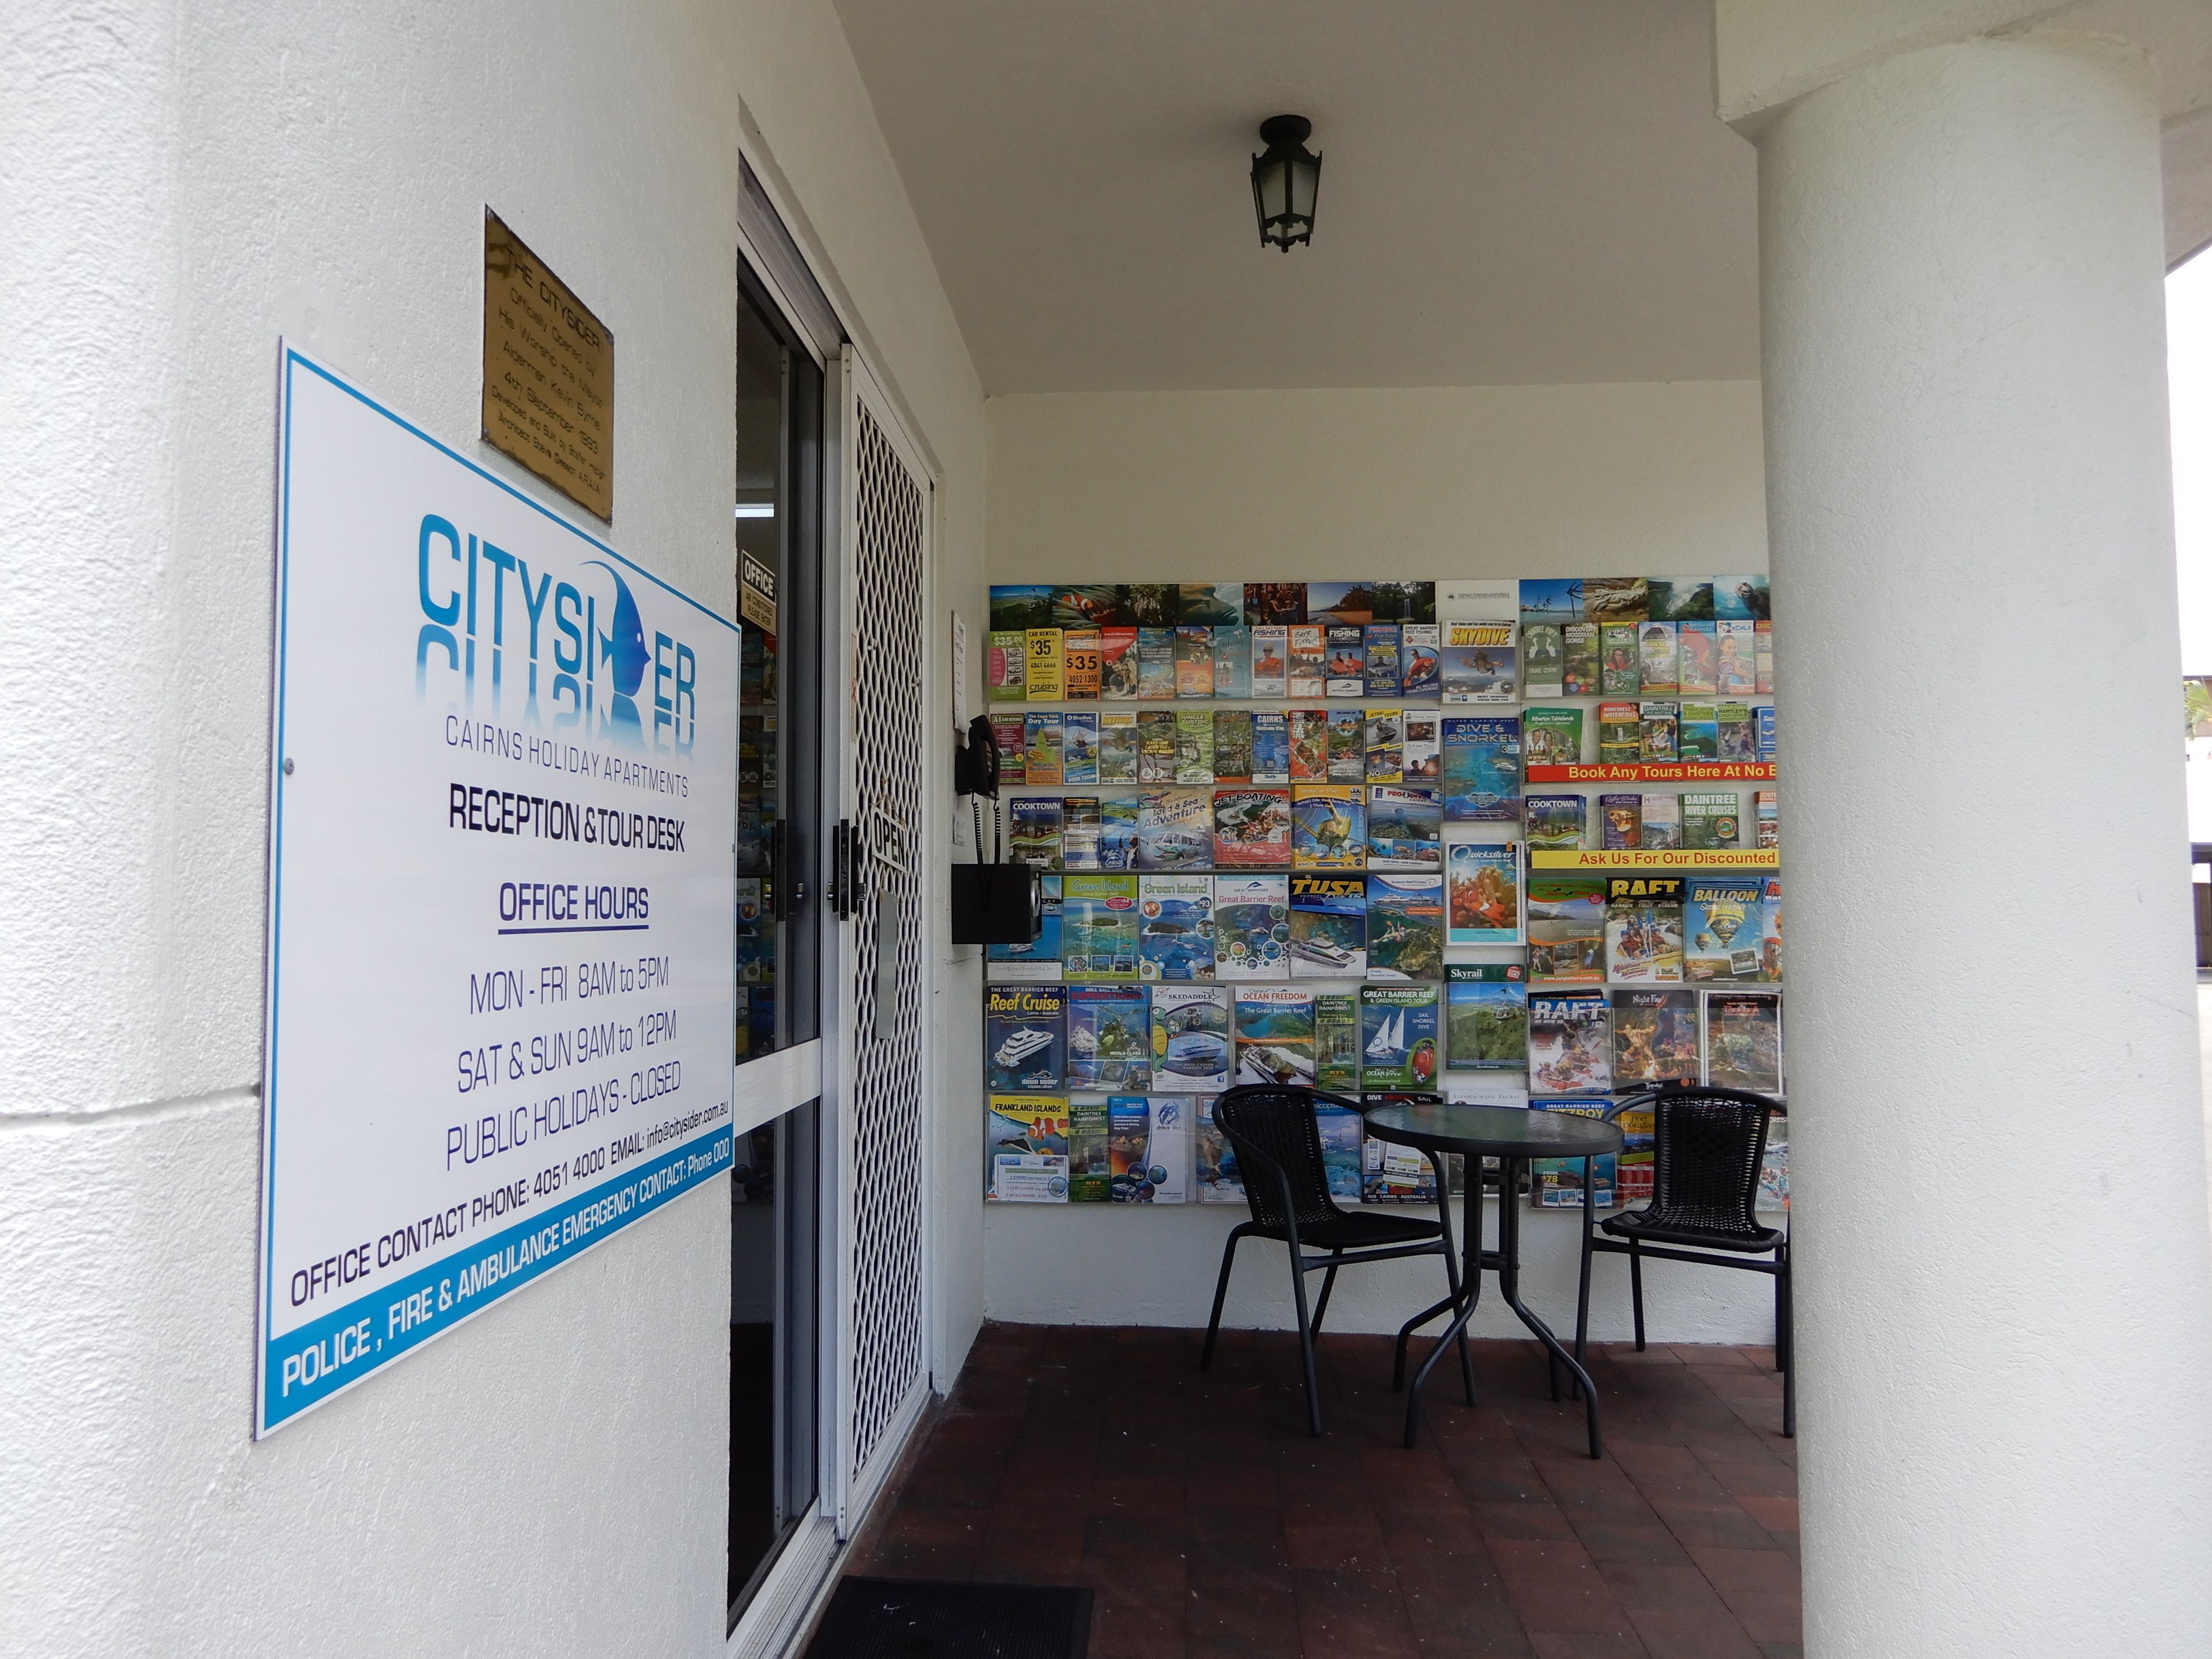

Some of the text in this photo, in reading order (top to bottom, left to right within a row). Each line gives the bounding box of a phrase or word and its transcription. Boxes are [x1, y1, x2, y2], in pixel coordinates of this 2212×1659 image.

[505, 245, 600, 351] THE CITYSIDER
[520, 324, 556, 367] Worship
[503, 340, 546, 385] Alderman
[551, 378, 573, 407] Kevin
[505, 372, 522, 392] 4th
[528, 387, 574, 433] September
[744, 559, 774, 598] OFFICE
[1329, 630, 1360, 638] FISHING
[1449, 628, 1512, 646] SKYDIVE
[1066, 656, 1098, 671] $35
[1029, 682, 1059, 694] cruising
[1069, 675, 1098, 684] 4052 1300
[1257, 715, 1284, 724] CAIRNS
[1456, 724, 1505, 733] DIVE &
[1447, 734, 1517, 743] SNORKEL
[446, 715, 689, 798] CAIRNS HOLIDAY APARTMENTS
[1569, 766, 1606, 778] Book
[1610, 766, 1638, 781] Any
[1642, 766, 1683, 777] Tours
[1687, 765, 1721, 777] Here
[1724, 765, 1742, 777] At
[1744, 765, 1764, 777] No
[1013, 802, 1060, 810] COOKTOWN
[1684, 794, 1737, 805] DAINTREE
[449, 782, 580, 842] RECEPTION
[647, 815, 685, 853] DESK
[1143, 804, 1206, 829] Adventure
[1684, 805, 1737, 815] RIVER CRUISES
[874, 811, 906, 868] OPEN
[1451, 845, 1515, 863] Quicksilver
[1579, 852, 1775, 865] Ask Us For Our Discounted
[1072, 879, 1129, 892] Green Island
[1145, 883, 1208, 894] Green Island
[1292, 879, 1365, 895] TUSA
[1611, 880, 1680, 897] RAFT
[499, 882, 649, 921] OFFICE HOURS
[1693, 889, 1759, 902] BALLOON
[1450, 968, 1483, 979] Skyrail
[470, 969, 523, 1014] MON
[540, 965, 567, 1005] FRI
[578, 961, 616, 999] 8AM
[620, 964, 634, 993] to
[638, 956, 669, 990] 5PM
[990, 993, 1060, 1011] Reef Cruise
[1534, 1001, 1604, 1020] RAFT
[458, 1010, 677, 1093] SAT & SUN 9AM to 12PM
[447, 1105, 528, 1172] PUBLIC
[534, 1079, 619, 1141] HOLIDAYS
[630, 1060, 681, 1105] CLOSED
[995, 1103, 1061, 1112] FRANKLAND ISLANDS
[291, 1100, 729, 1306] OFFICE CONTACT PHONE: 4051 4000 EMAIL: info@citysider.com.au
[282, 1317, 371, 1398] POLICE
[388, 1285, 433, 1341] FIRE
[438, 1278, 453, 1312] &
[457, 1222, 560, 1304] AMBULANCE
[562, 1183, 638, 1246] EMERGENCY
[639, 1161, 687, 1203] CONTACT:
[687, 1150, 713, 1178] Phone
[714, 1137, 730, 1163] 000
